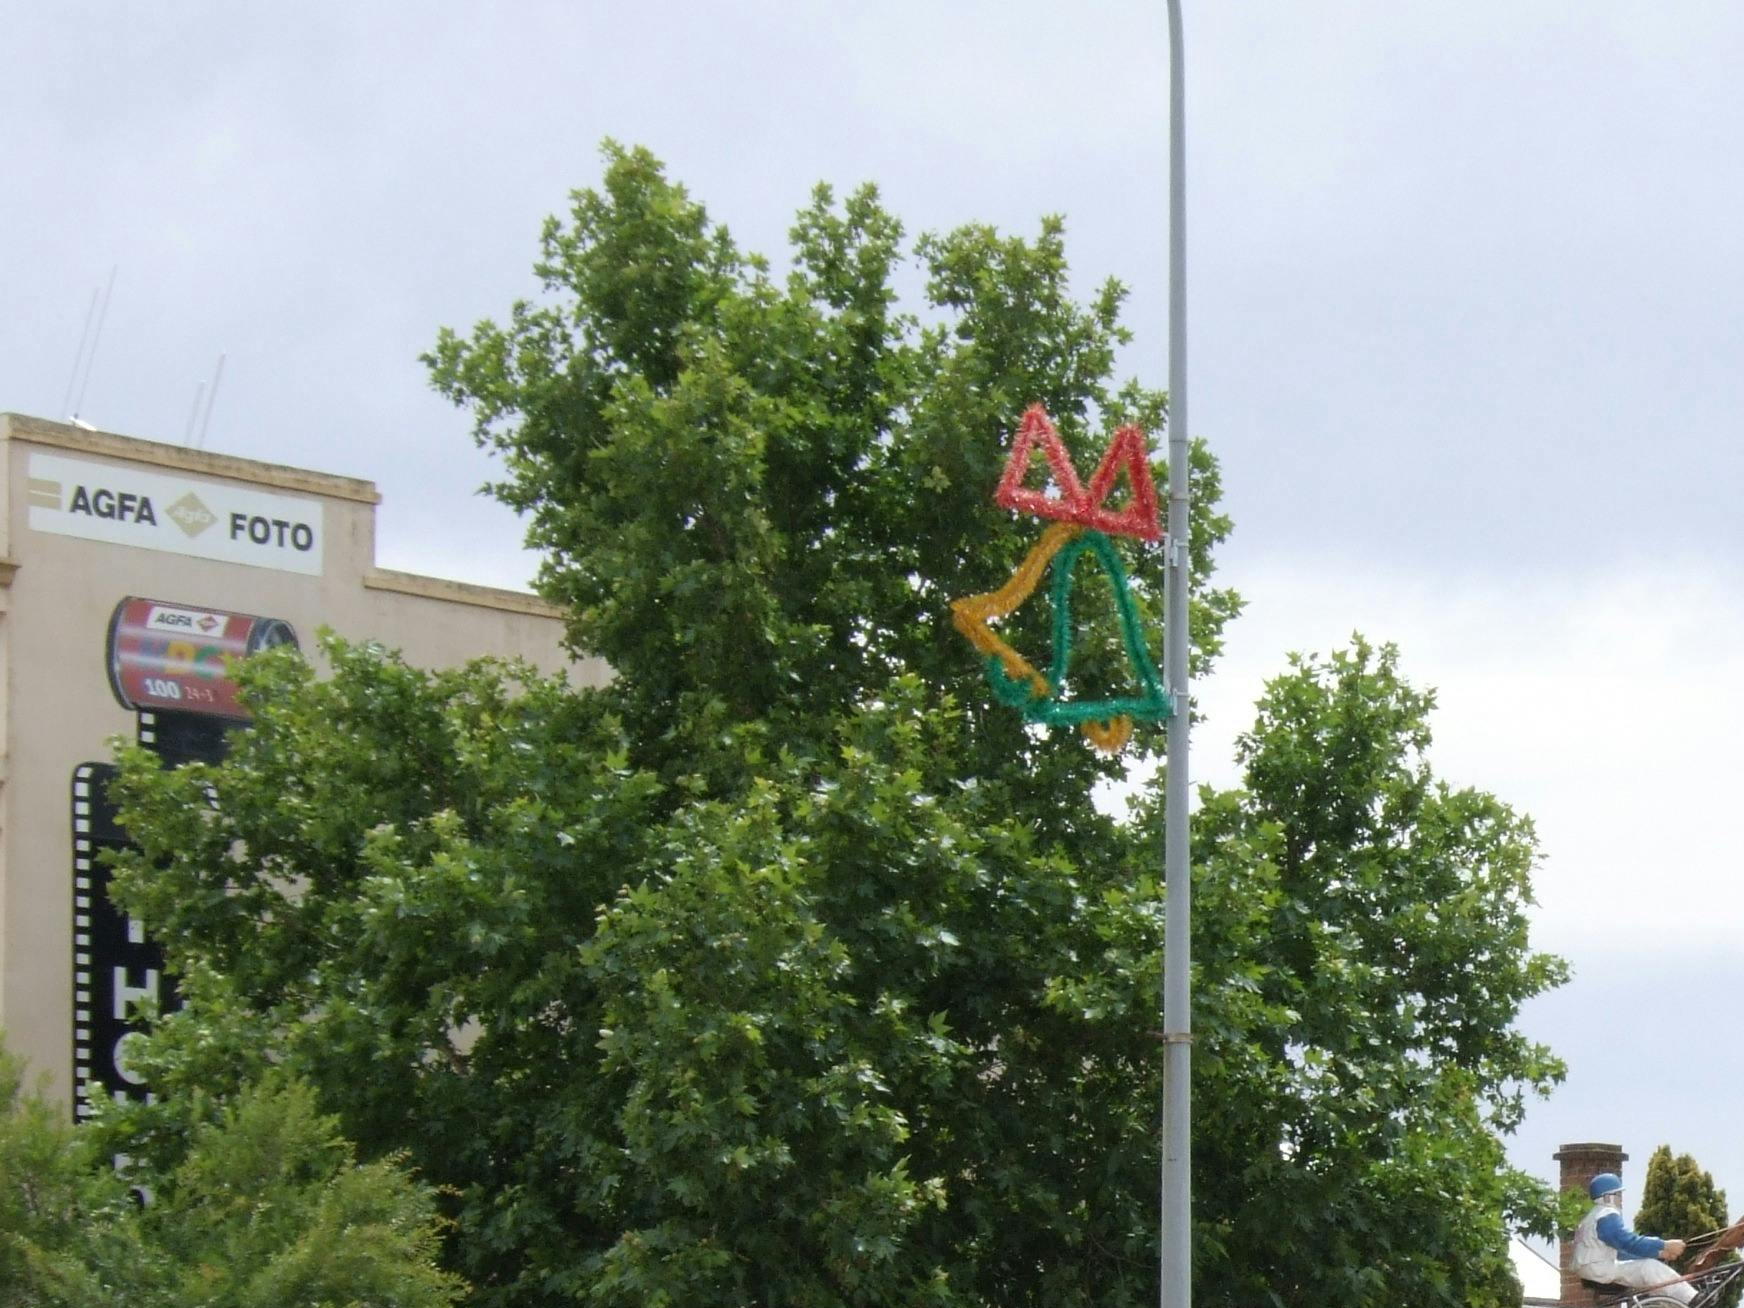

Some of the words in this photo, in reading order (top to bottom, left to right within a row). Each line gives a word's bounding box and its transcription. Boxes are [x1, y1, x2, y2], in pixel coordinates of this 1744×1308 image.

[69, 484, 157, 527] AGFA
[229, 511, 314, 552] FOTO
[155, 612, 193, 628] AGFA
[144, 678, 180, 699] 100
